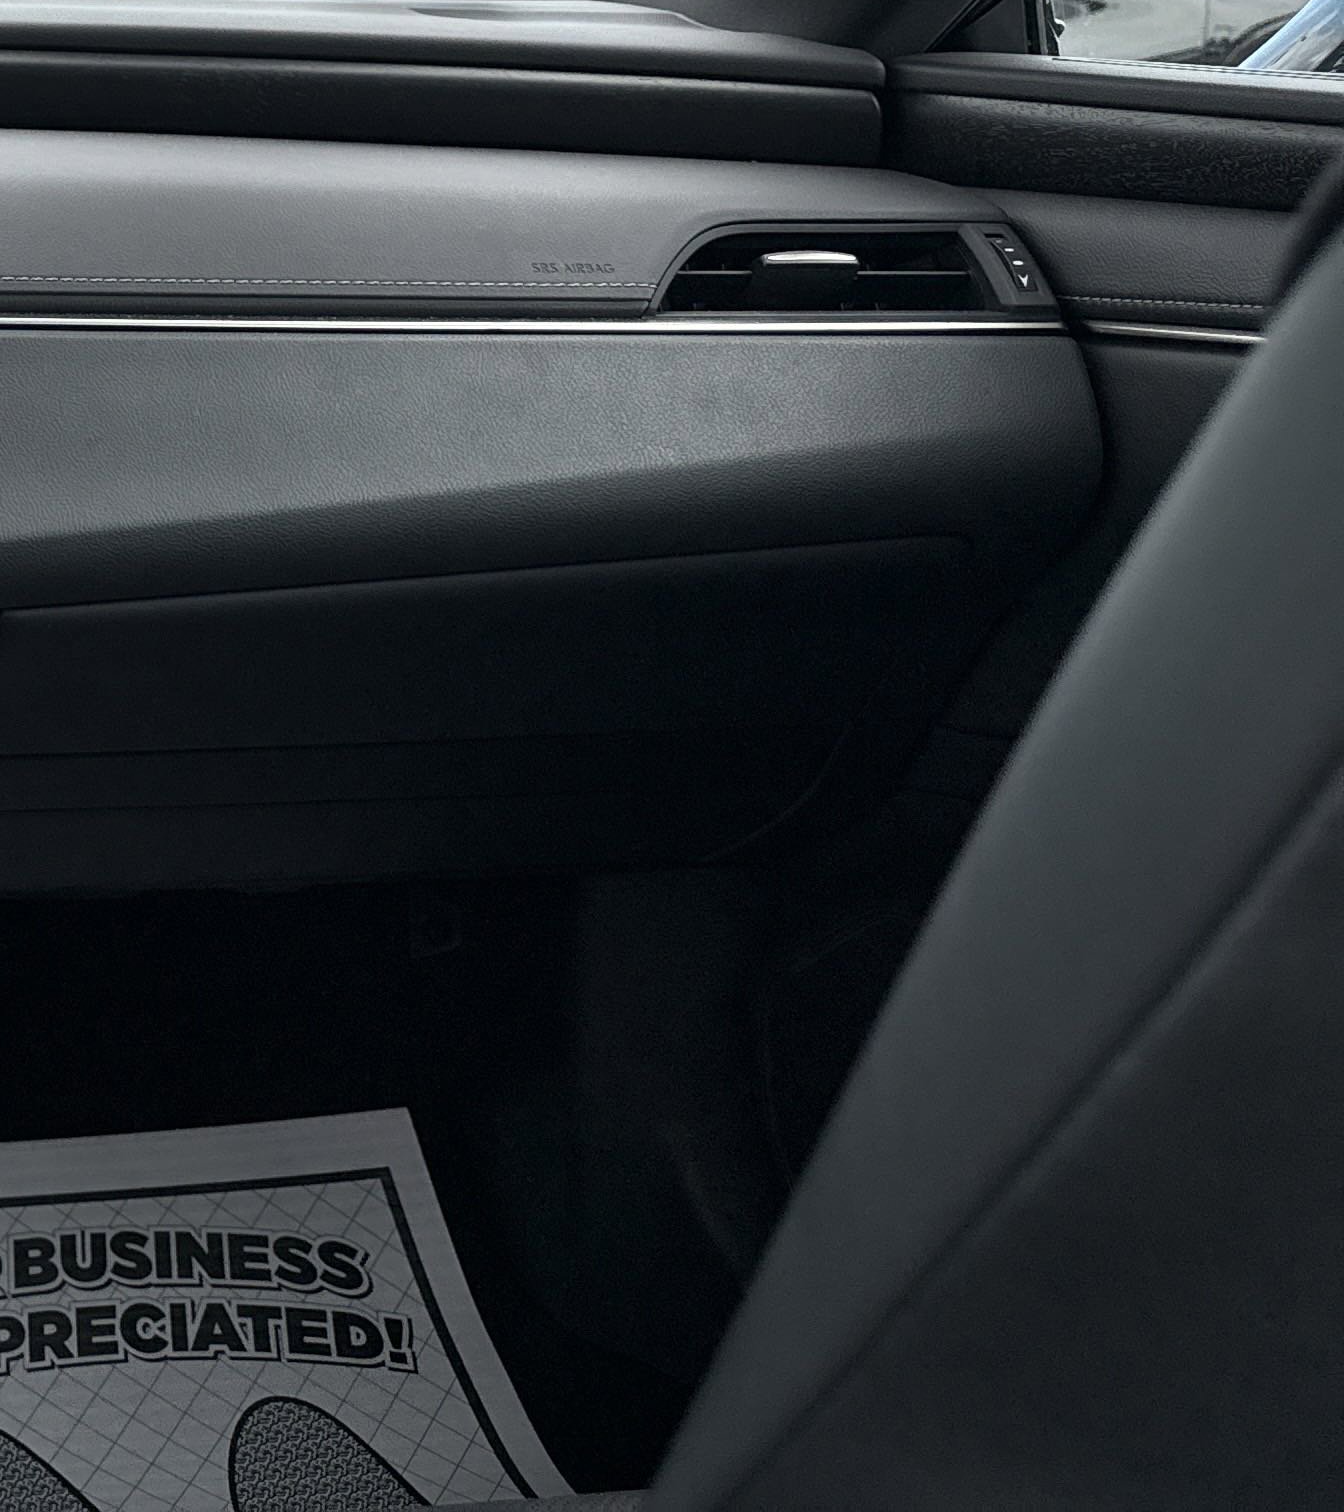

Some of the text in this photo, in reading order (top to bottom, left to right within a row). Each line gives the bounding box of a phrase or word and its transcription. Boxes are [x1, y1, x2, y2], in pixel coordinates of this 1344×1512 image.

[531, 262, 616, 274] SRS AIRBAG
[13, 1230, 366, 1292] BUSINESS
